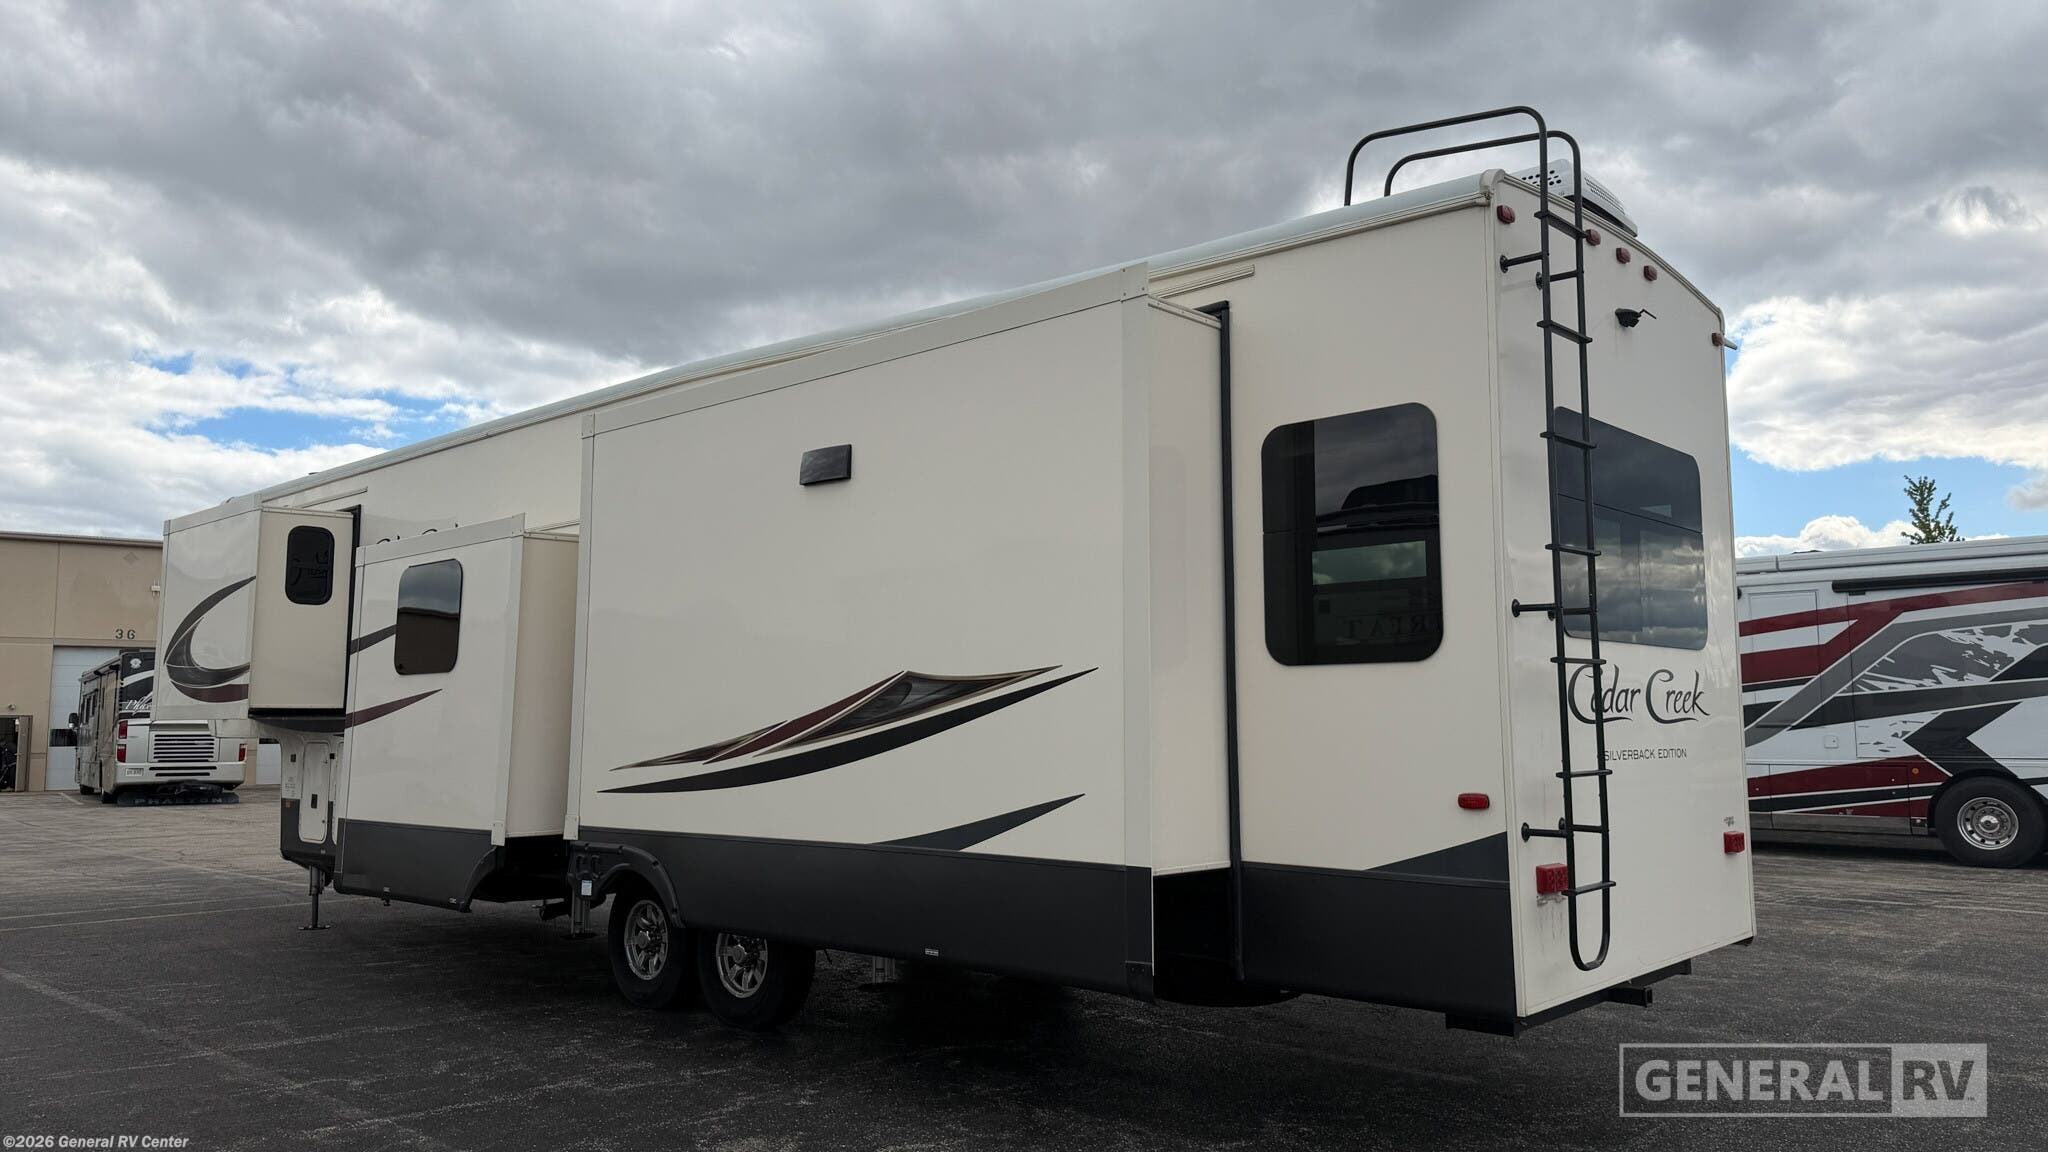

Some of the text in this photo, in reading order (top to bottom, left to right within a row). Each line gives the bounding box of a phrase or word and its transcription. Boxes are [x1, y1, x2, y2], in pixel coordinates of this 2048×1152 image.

[115, 628, 136, 640] 36
[1645, 668, 1710, 724] Creek
[1604, 748, 1687, 761] SILVERBACK EDITION
